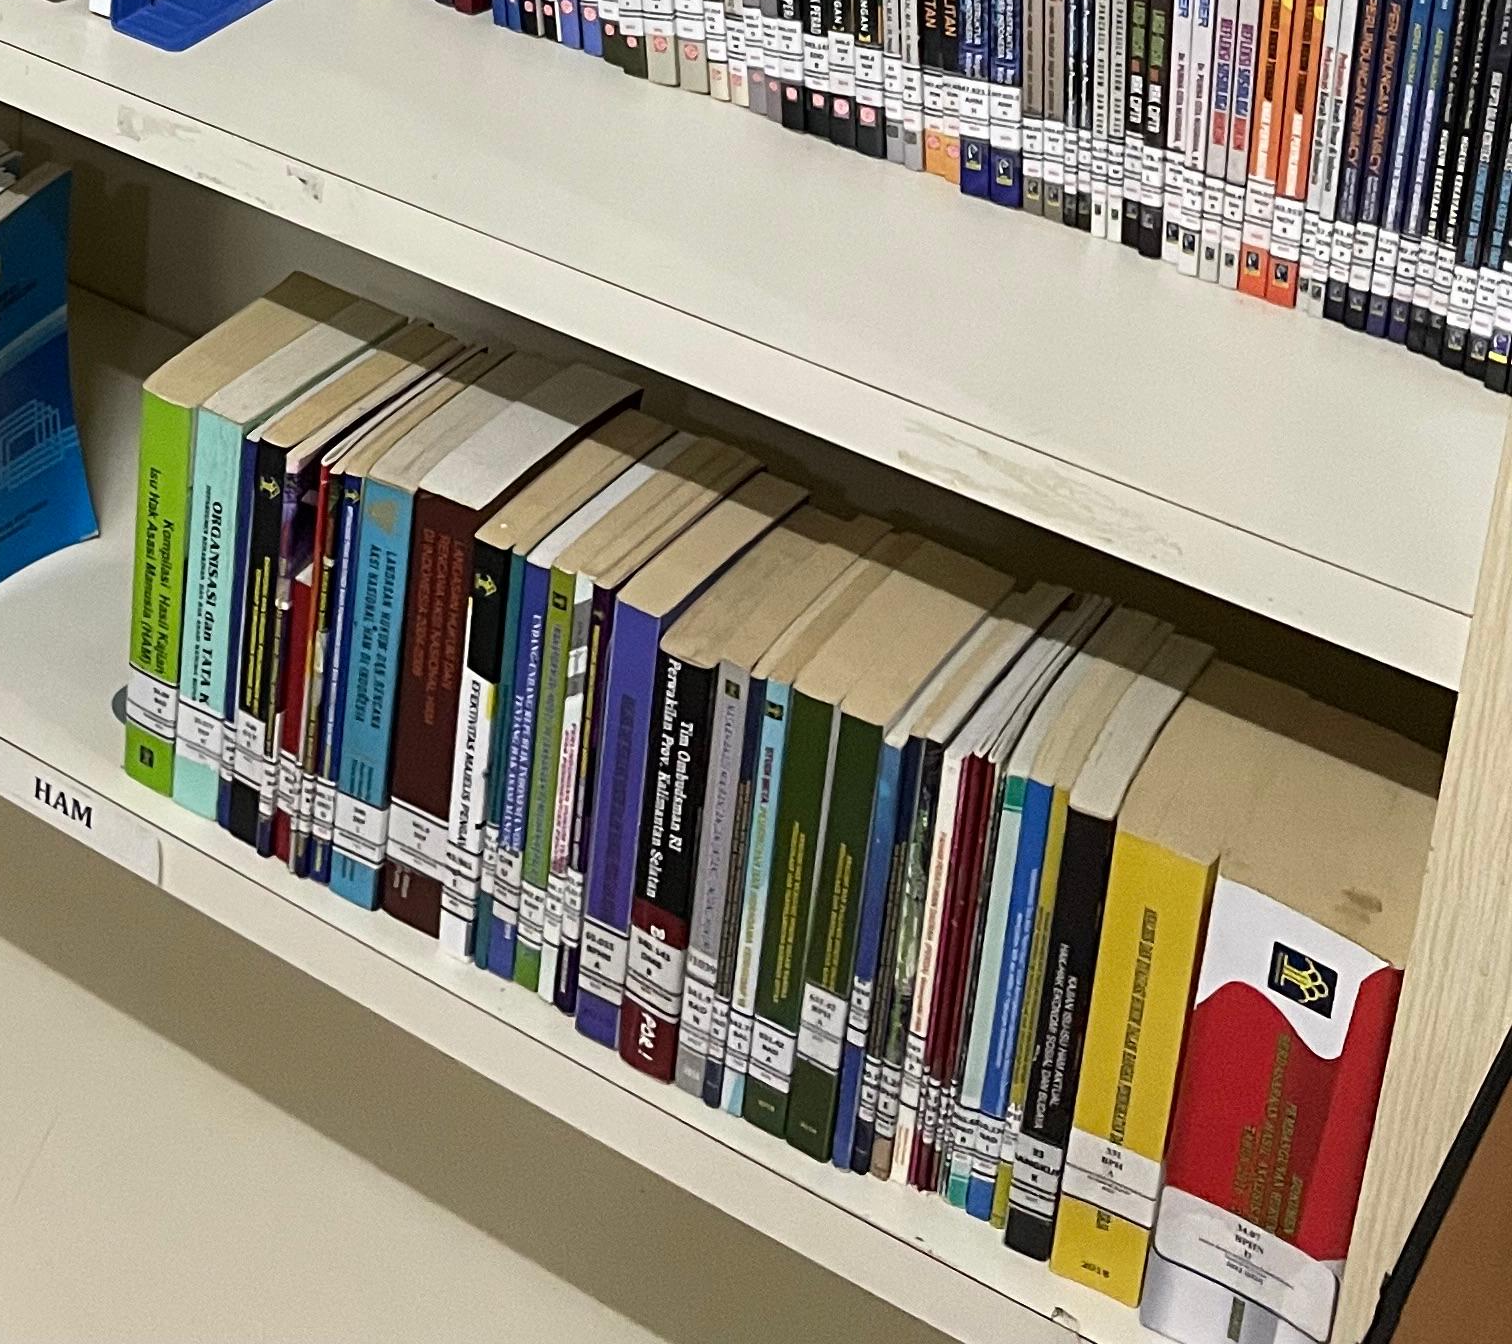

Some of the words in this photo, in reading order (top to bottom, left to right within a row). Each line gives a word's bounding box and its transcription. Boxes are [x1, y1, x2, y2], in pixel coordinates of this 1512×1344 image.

[1376, 3, 1401, 113] PERLINDUNGAN
[1369, 115, 1387, 174] PRIVACY
[148, 467, 161, 489] Isu
[147, 493, 160, 517] Hak
[145, 522, 158, 559] Asasi
[158, 520, 175, 587] Kompilasi
[142, 563, 156, 618] Manusia
[156, 596, 170, 629] Hasil
[139, 621, 153, 663] (HAM)
[154, 632, 168, 674] Kajian
[465, 680, 481, 750] EFEKTIVITAS
[662, 658, 682, 730] Perwakilan
[658, 734, 675, 766] Prov.
[677, 721, 693, 746] Tim
[461, 753, 474, 800] MAJELIS
[670, 751, 690, 832] Ombudsman
[34, 776, 92, 830] HAM
[651, 771, 672, 846] Kalimantan
[668, 835, 683, 851] RI
[646, 850, 665, 898] Selatan
